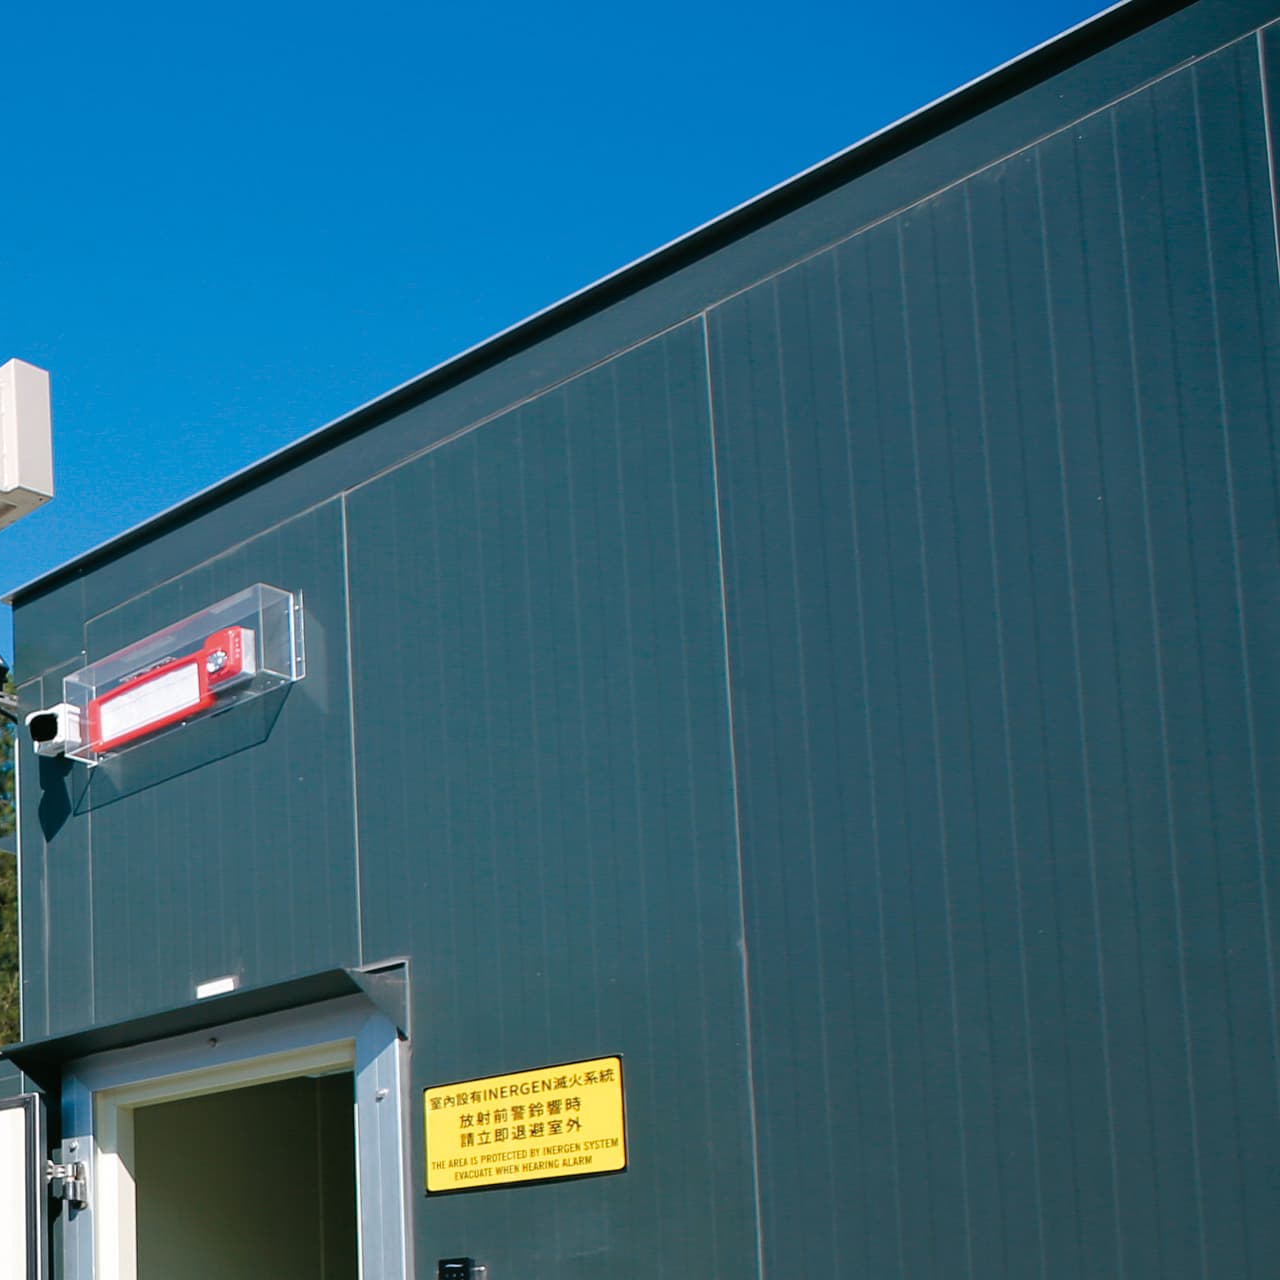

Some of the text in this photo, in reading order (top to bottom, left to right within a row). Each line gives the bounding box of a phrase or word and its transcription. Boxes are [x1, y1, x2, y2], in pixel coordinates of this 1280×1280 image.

[459, 1096, 582, 1129] 放射前警鈴響時
[460, 1117, 582, 1148] 請立即退避室外
[431, 1138, 619, 1171] THE AREA IS PROTECTED BY INERGEN SYSTEM
[454, 1155, 593, 1181] EVACUATE WHEN HEARING ALARM
